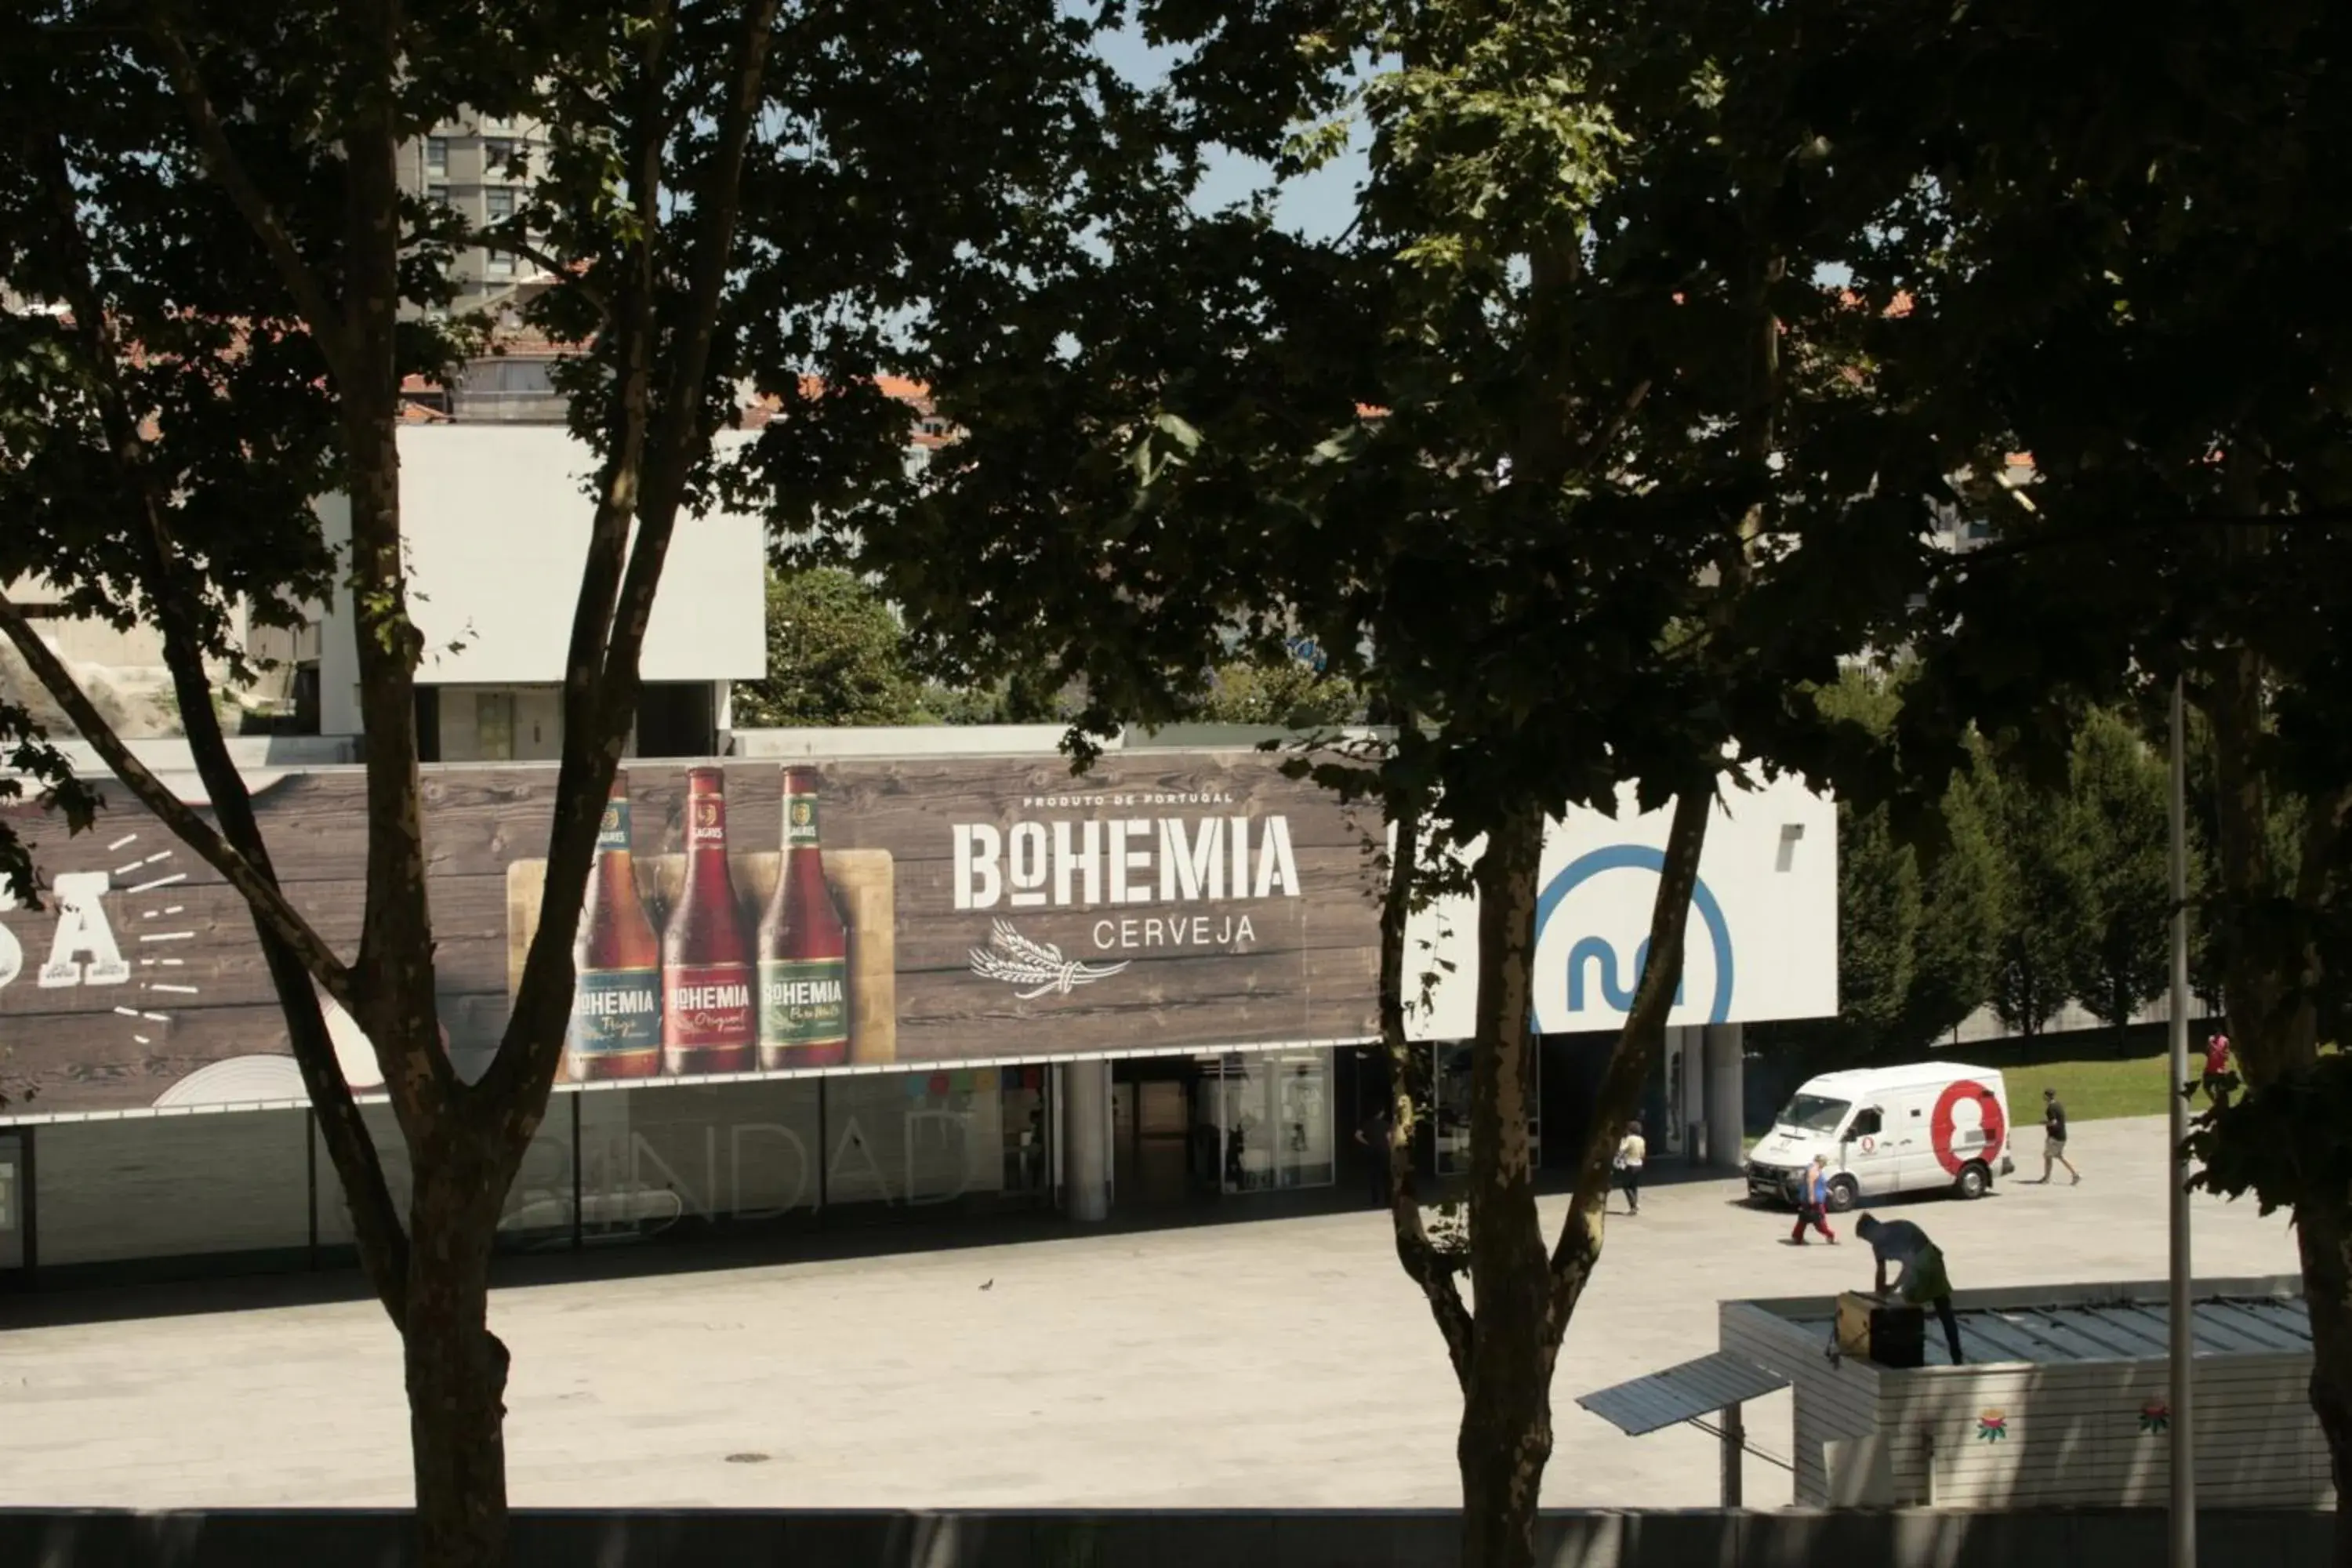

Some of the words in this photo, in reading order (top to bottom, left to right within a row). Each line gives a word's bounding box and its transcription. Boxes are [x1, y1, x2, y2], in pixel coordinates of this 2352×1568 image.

[1023, 795, 1105, 808] PRODUTO
[1113, 794, 1135, 806] DE
[1143, 792, 1233, 804] PORTUGAL
[953, 815, 1301, 910] BOHEMIA
[1093, 915, 1256, 949] CERVEJA
[573, 990, 654, 1015] OHEMIA
[669, 985, 750, 1011] BOHEMIA
[762, 981, 842, 1006] BOHEMIA
